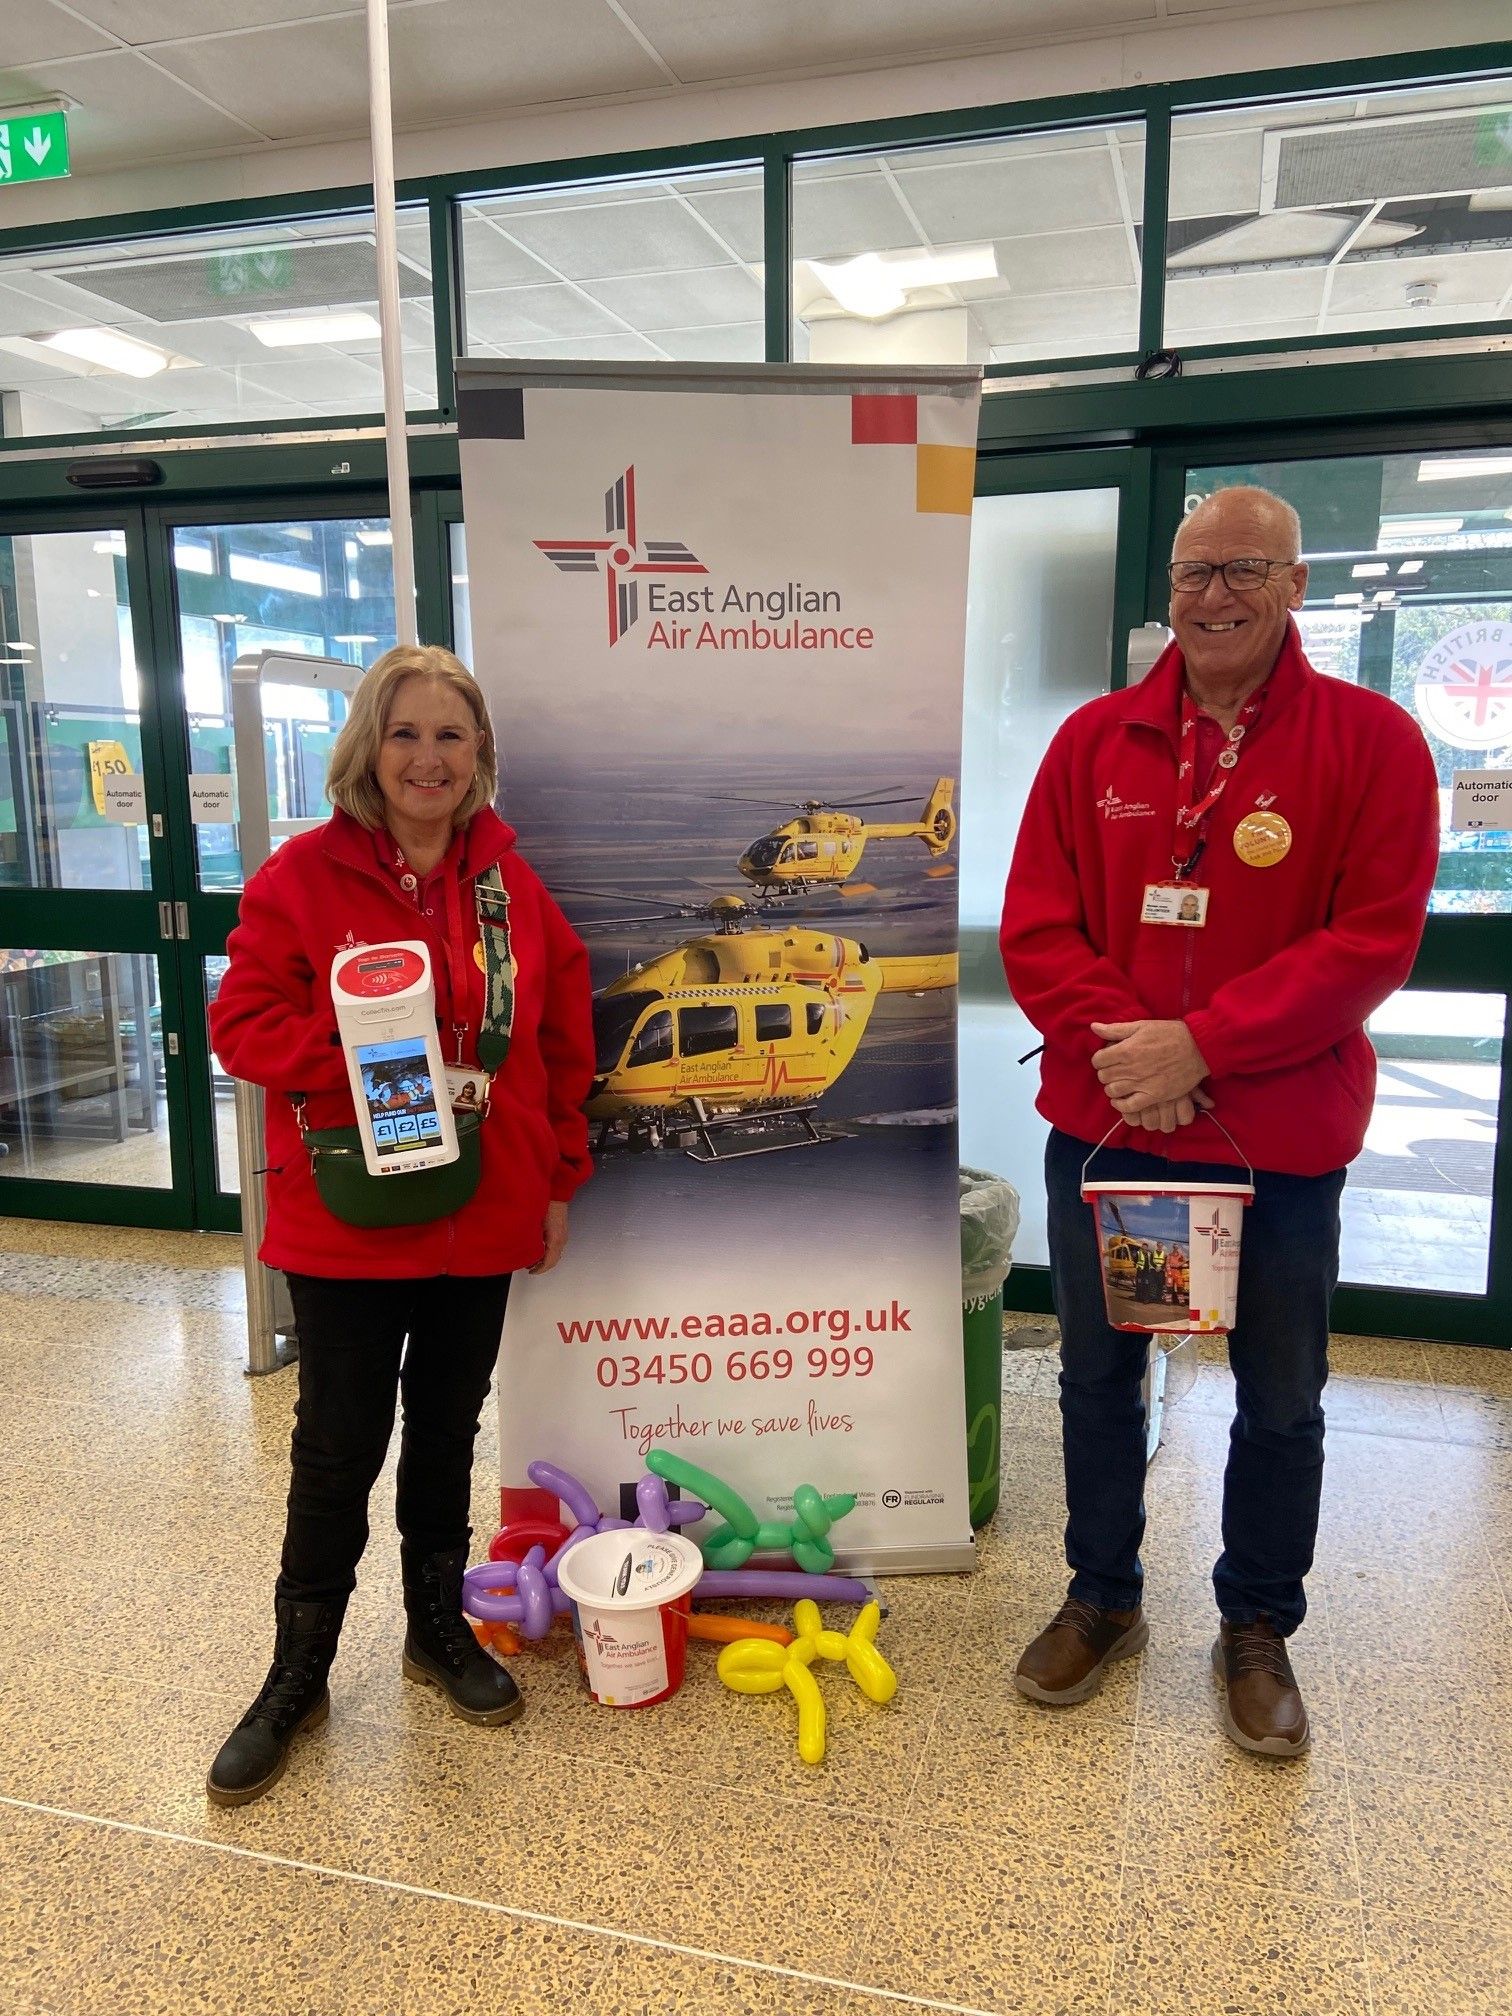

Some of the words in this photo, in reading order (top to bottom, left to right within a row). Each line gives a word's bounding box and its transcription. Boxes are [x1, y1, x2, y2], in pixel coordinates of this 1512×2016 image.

[648, 582, 715, 613] East
[721, 582, 841, 620] Anglian
[647, 619, 692, 649] Air
[695, 619, 874, 649] Ambulance
[106, 790, 142, 798] Automatic
[192, 790, 229, 798] Automatic
[1471, 793, 1500, 802] door
[116, 800, 133, 808] door
[681, 1063, 699, 1073] East
[700, 1060, 732, 1073] Anglian
[680, 1075, 691, 1084] Air
[692, 1073, 739, 1083] Ambulance
[398, 1121, 416, 1132] £2
[421, 1118, 437, 1129] £5
[378, 1125, 391, 1136] £1
[556, 1301, 912, 1344] www.eaaa.org.uk
[597, 1353, 713, 1388] 03450
[726, 1349, 793, 1381] 669
[806, 1346, 874, 1378] 999
[609, 1404, 713, 1454] Together
[717, 1418, 746, 1437] we
[751, 1416, 802, 1437] save
[807, 1399, 855, 1437] lives
[885, 1495, 899, 1503] FR
[904, 1498, 945, 1506] REGULATOR
[647, 1544, 672, 1555] PLEASE
[644, 1563, 678, 1591] GENEROUSLY
[604, 1643, 620, 1651] East
[621, 1640, 650, 1650] Anglian
[617, 1645, 658, 1659] Ambulance
